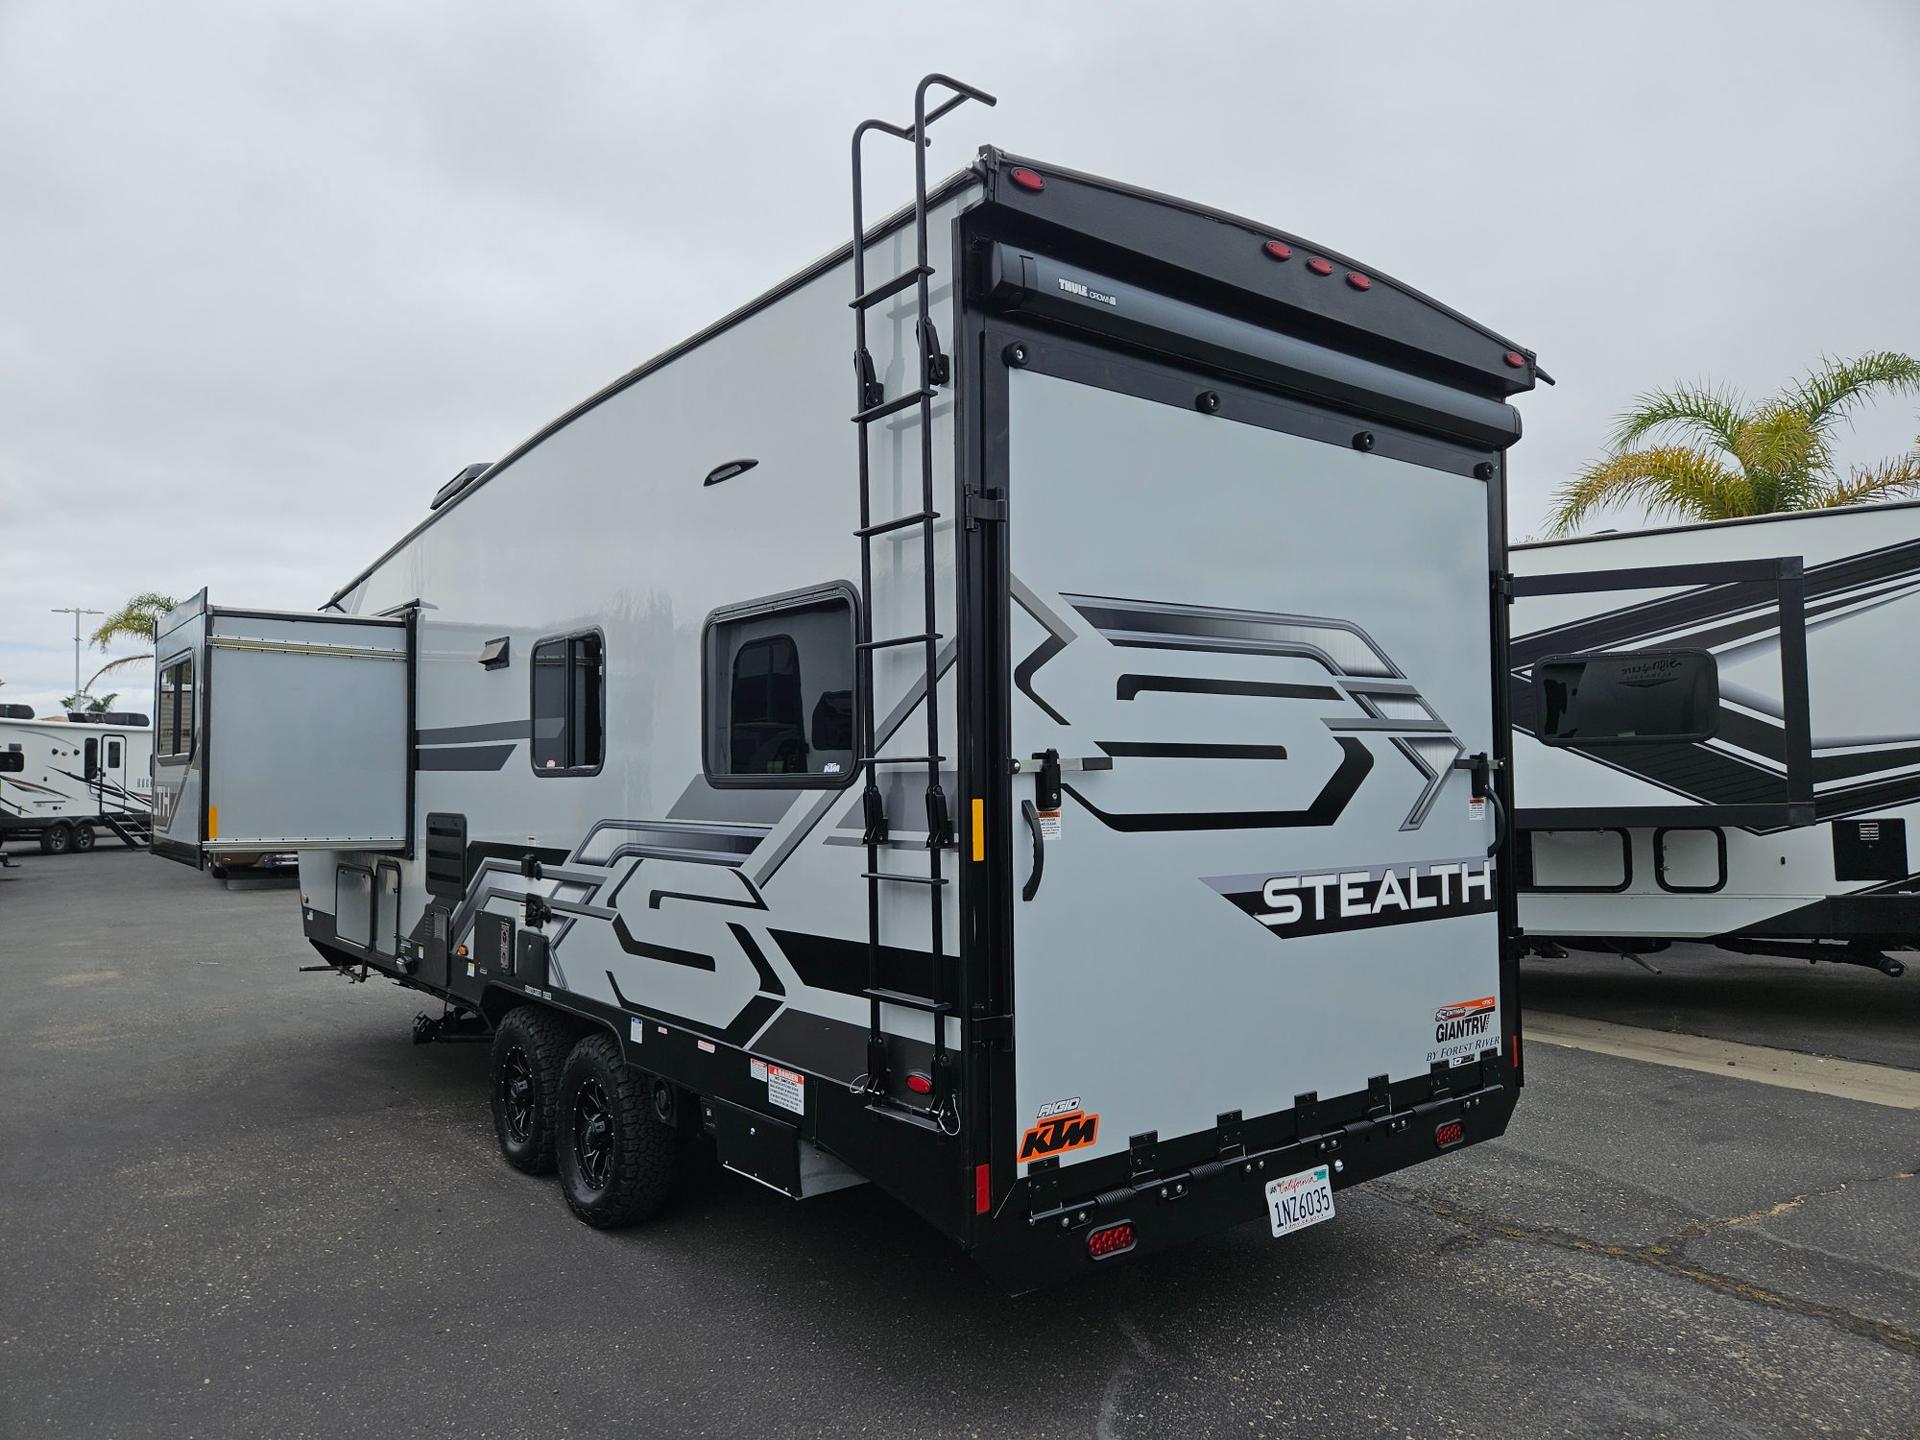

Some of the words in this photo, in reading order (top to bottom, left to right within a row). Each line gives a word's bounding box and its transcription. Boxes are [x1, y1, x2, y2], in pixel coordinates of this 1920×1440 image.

[1059, 278, 1088, 297] THULE
[1254, 860, 1492, 926] STEALTH
[1426, 1050, 1438, 1061] BY
[1037, 1097, 1081, 1118] RIGID
[1021, 1114, 1097, 1159] KTM
[1279, 1177, 1318, 1193] California
[1275, 1186, 1330, 1228] 1NZ6035
